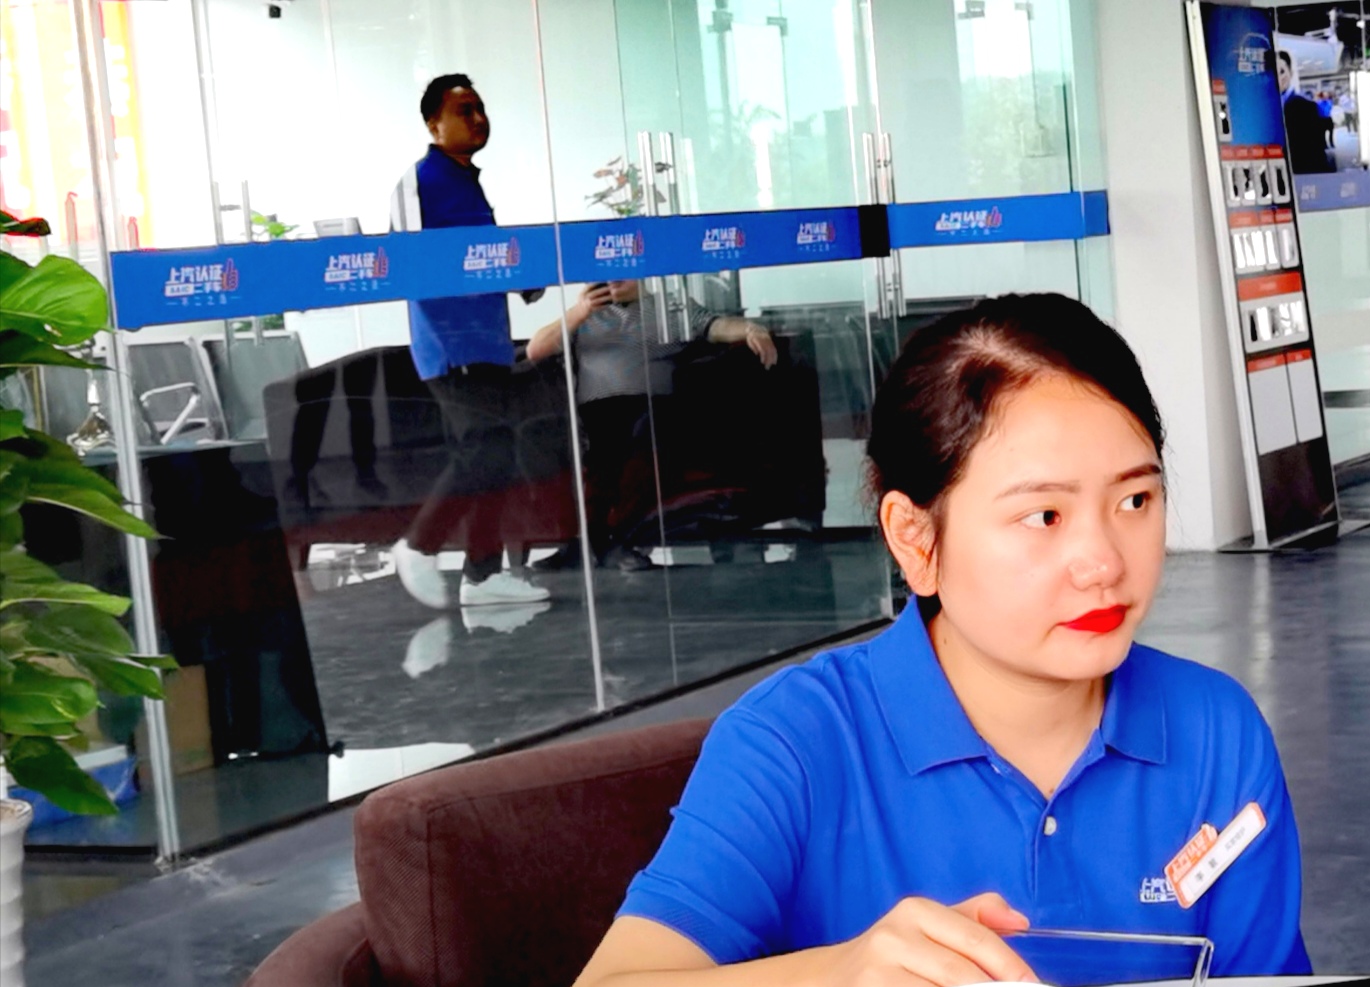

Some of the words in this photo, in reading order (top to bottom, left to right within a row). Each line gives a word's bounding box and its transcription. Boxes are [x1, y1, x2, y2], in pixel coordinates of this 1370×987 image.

[325, 251, 375, 271] 上汽认证
[464, 242, 509, 260] 上汽认证
[165, 263, 224, 285] 上汽认证
